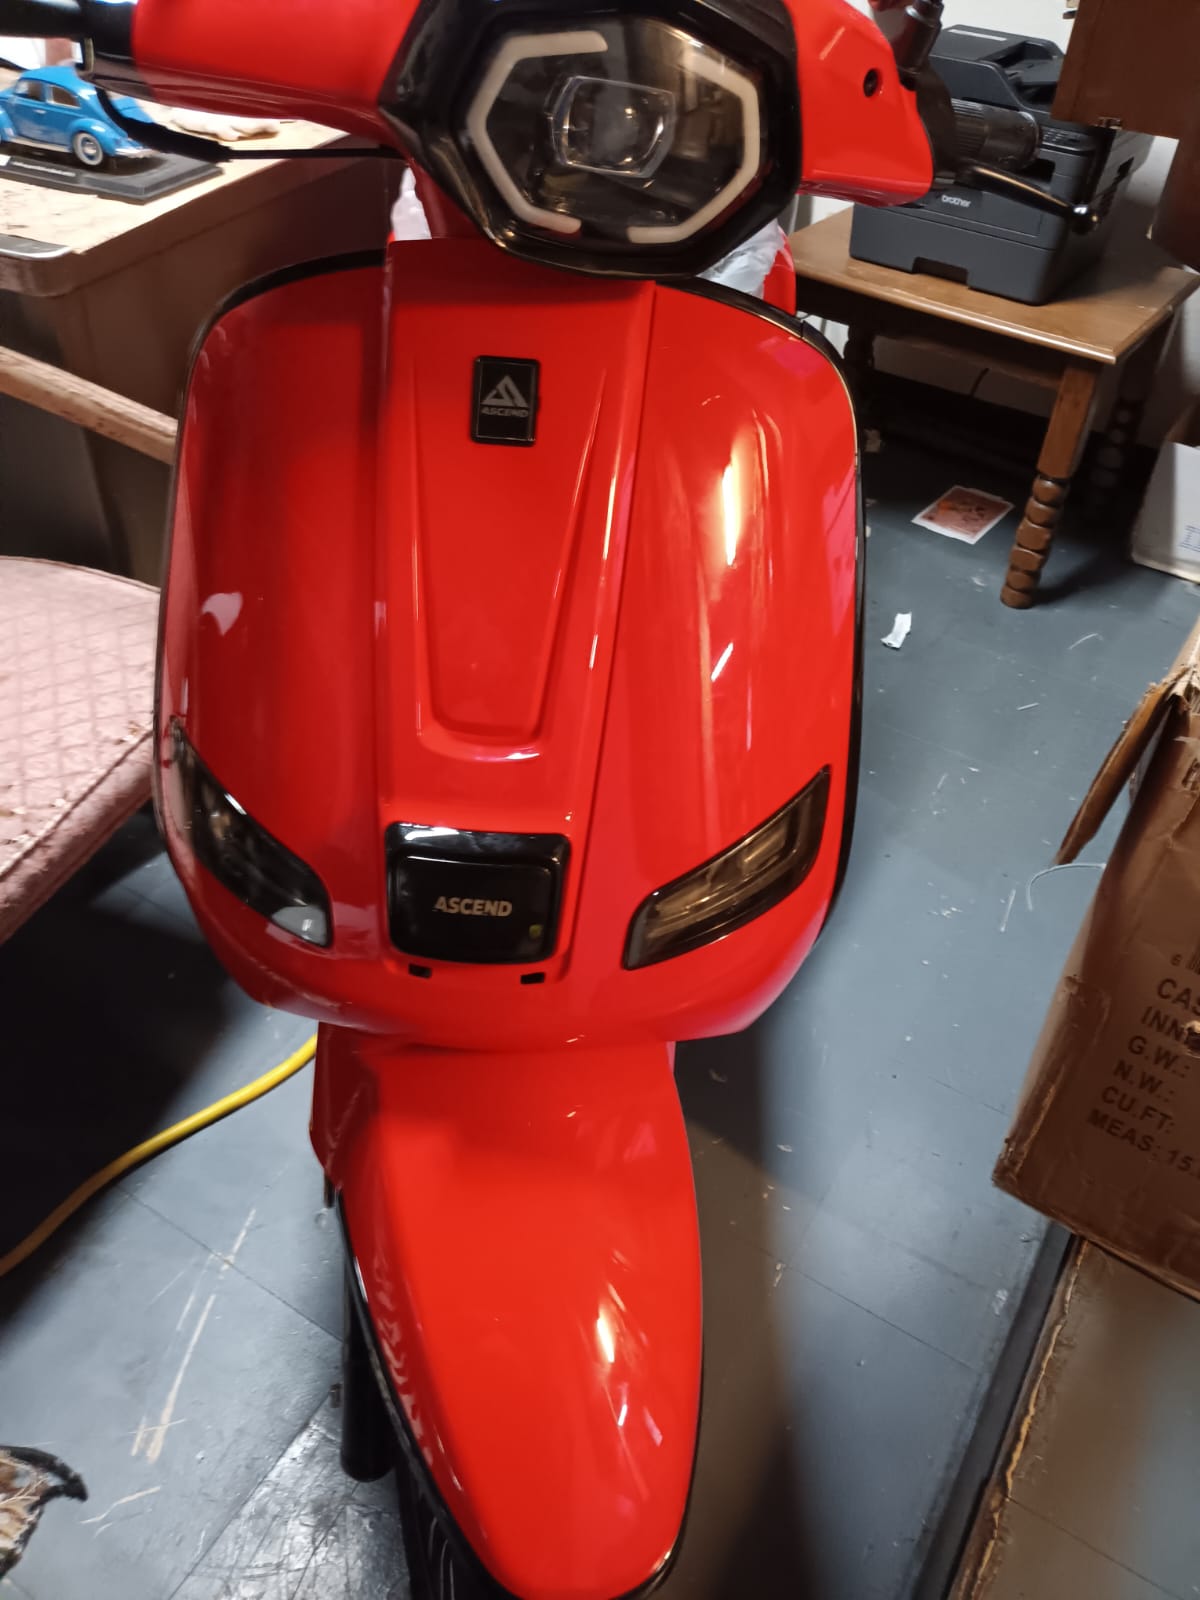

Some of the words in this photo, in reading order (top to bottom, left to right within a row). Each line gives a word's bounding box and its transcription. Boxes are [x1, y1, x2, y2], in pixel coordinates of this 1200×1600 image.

[941, 194, 971, 208] brother
[481, 406, 529, 418] ASCEND
[433, 896, 513, 917] ASCEND
[1141, 1006, 1191, 1045] INN
[1086, 1109, 1161, 1159] MEAS:
[1167, 1150, 1200, 1180] 15.
